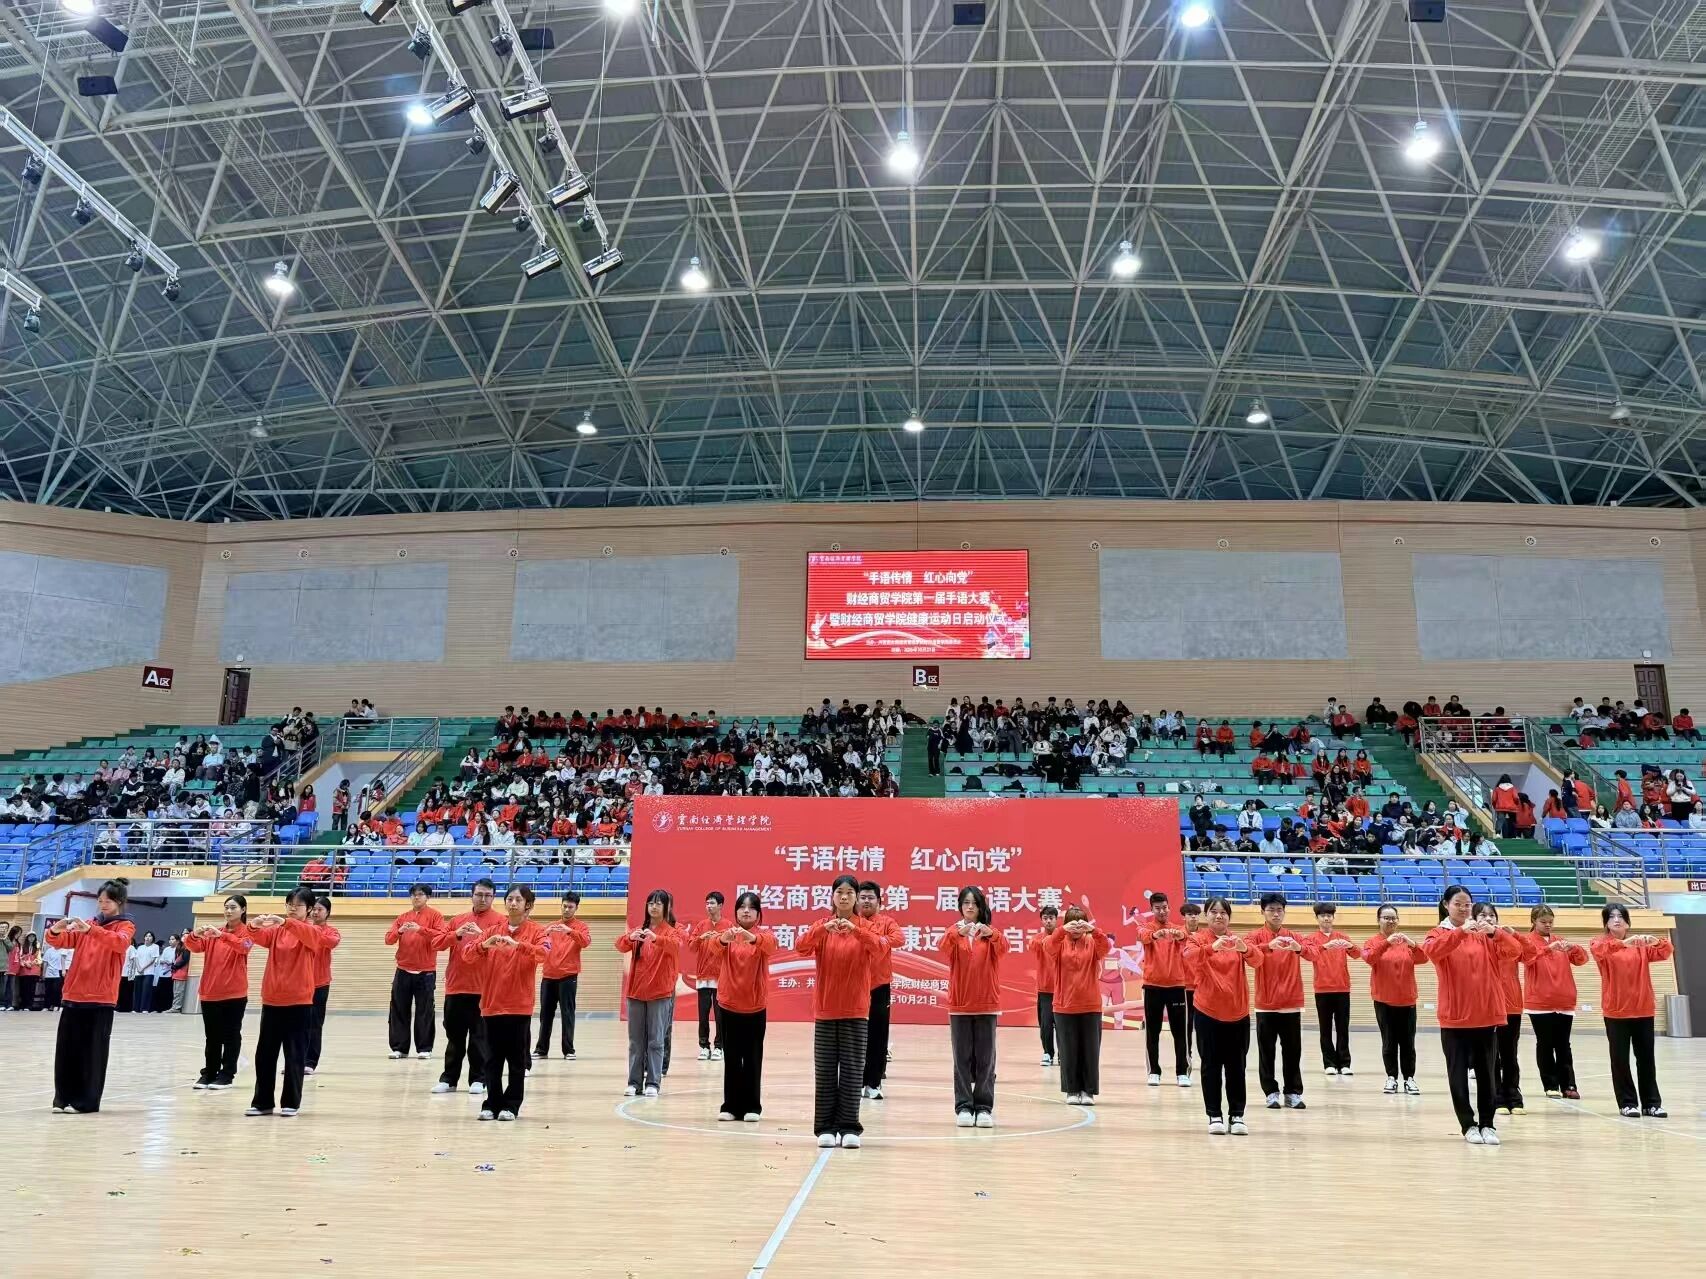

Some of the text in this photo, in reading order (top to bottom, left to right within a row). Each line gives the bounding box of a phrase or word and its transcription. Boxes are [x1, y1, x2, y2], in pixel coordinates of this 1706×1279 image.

[846, 591, 991, 606] 财经商贸学院第一届手语大赛
[144, 670, 170, 686] A区
[915, 668, 938, 684] B区
[774, 846, 1022, 872] “手语传情 红心向党”
[153, 868, 169, 876] 出口
